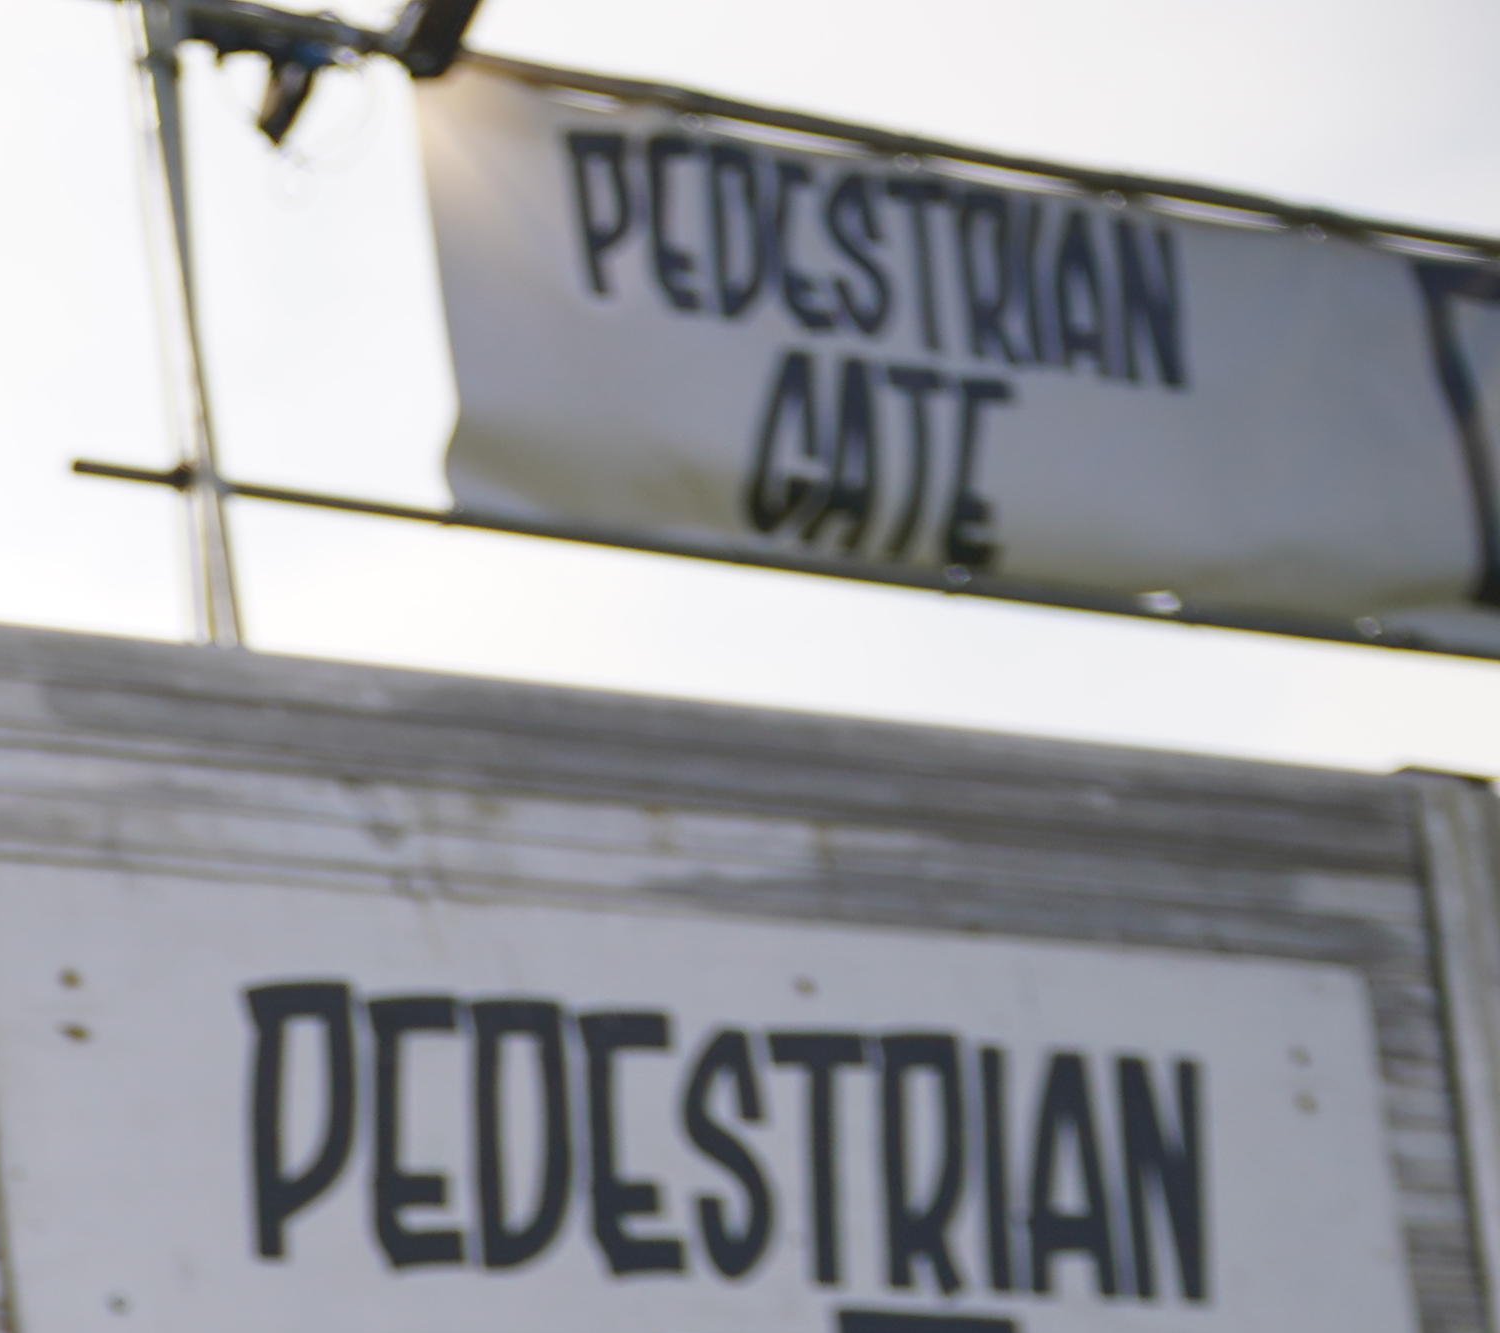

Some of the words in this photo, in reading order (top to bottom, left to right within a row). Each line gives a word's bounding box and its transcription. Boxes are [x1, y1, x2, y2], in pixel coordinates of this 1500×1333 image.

[567, 130, 1187, 388] PEDESTRIAN
[743, 346, 1017, 567] GATE
[243, 978, 1210, 1305] PEDESTRIAN
